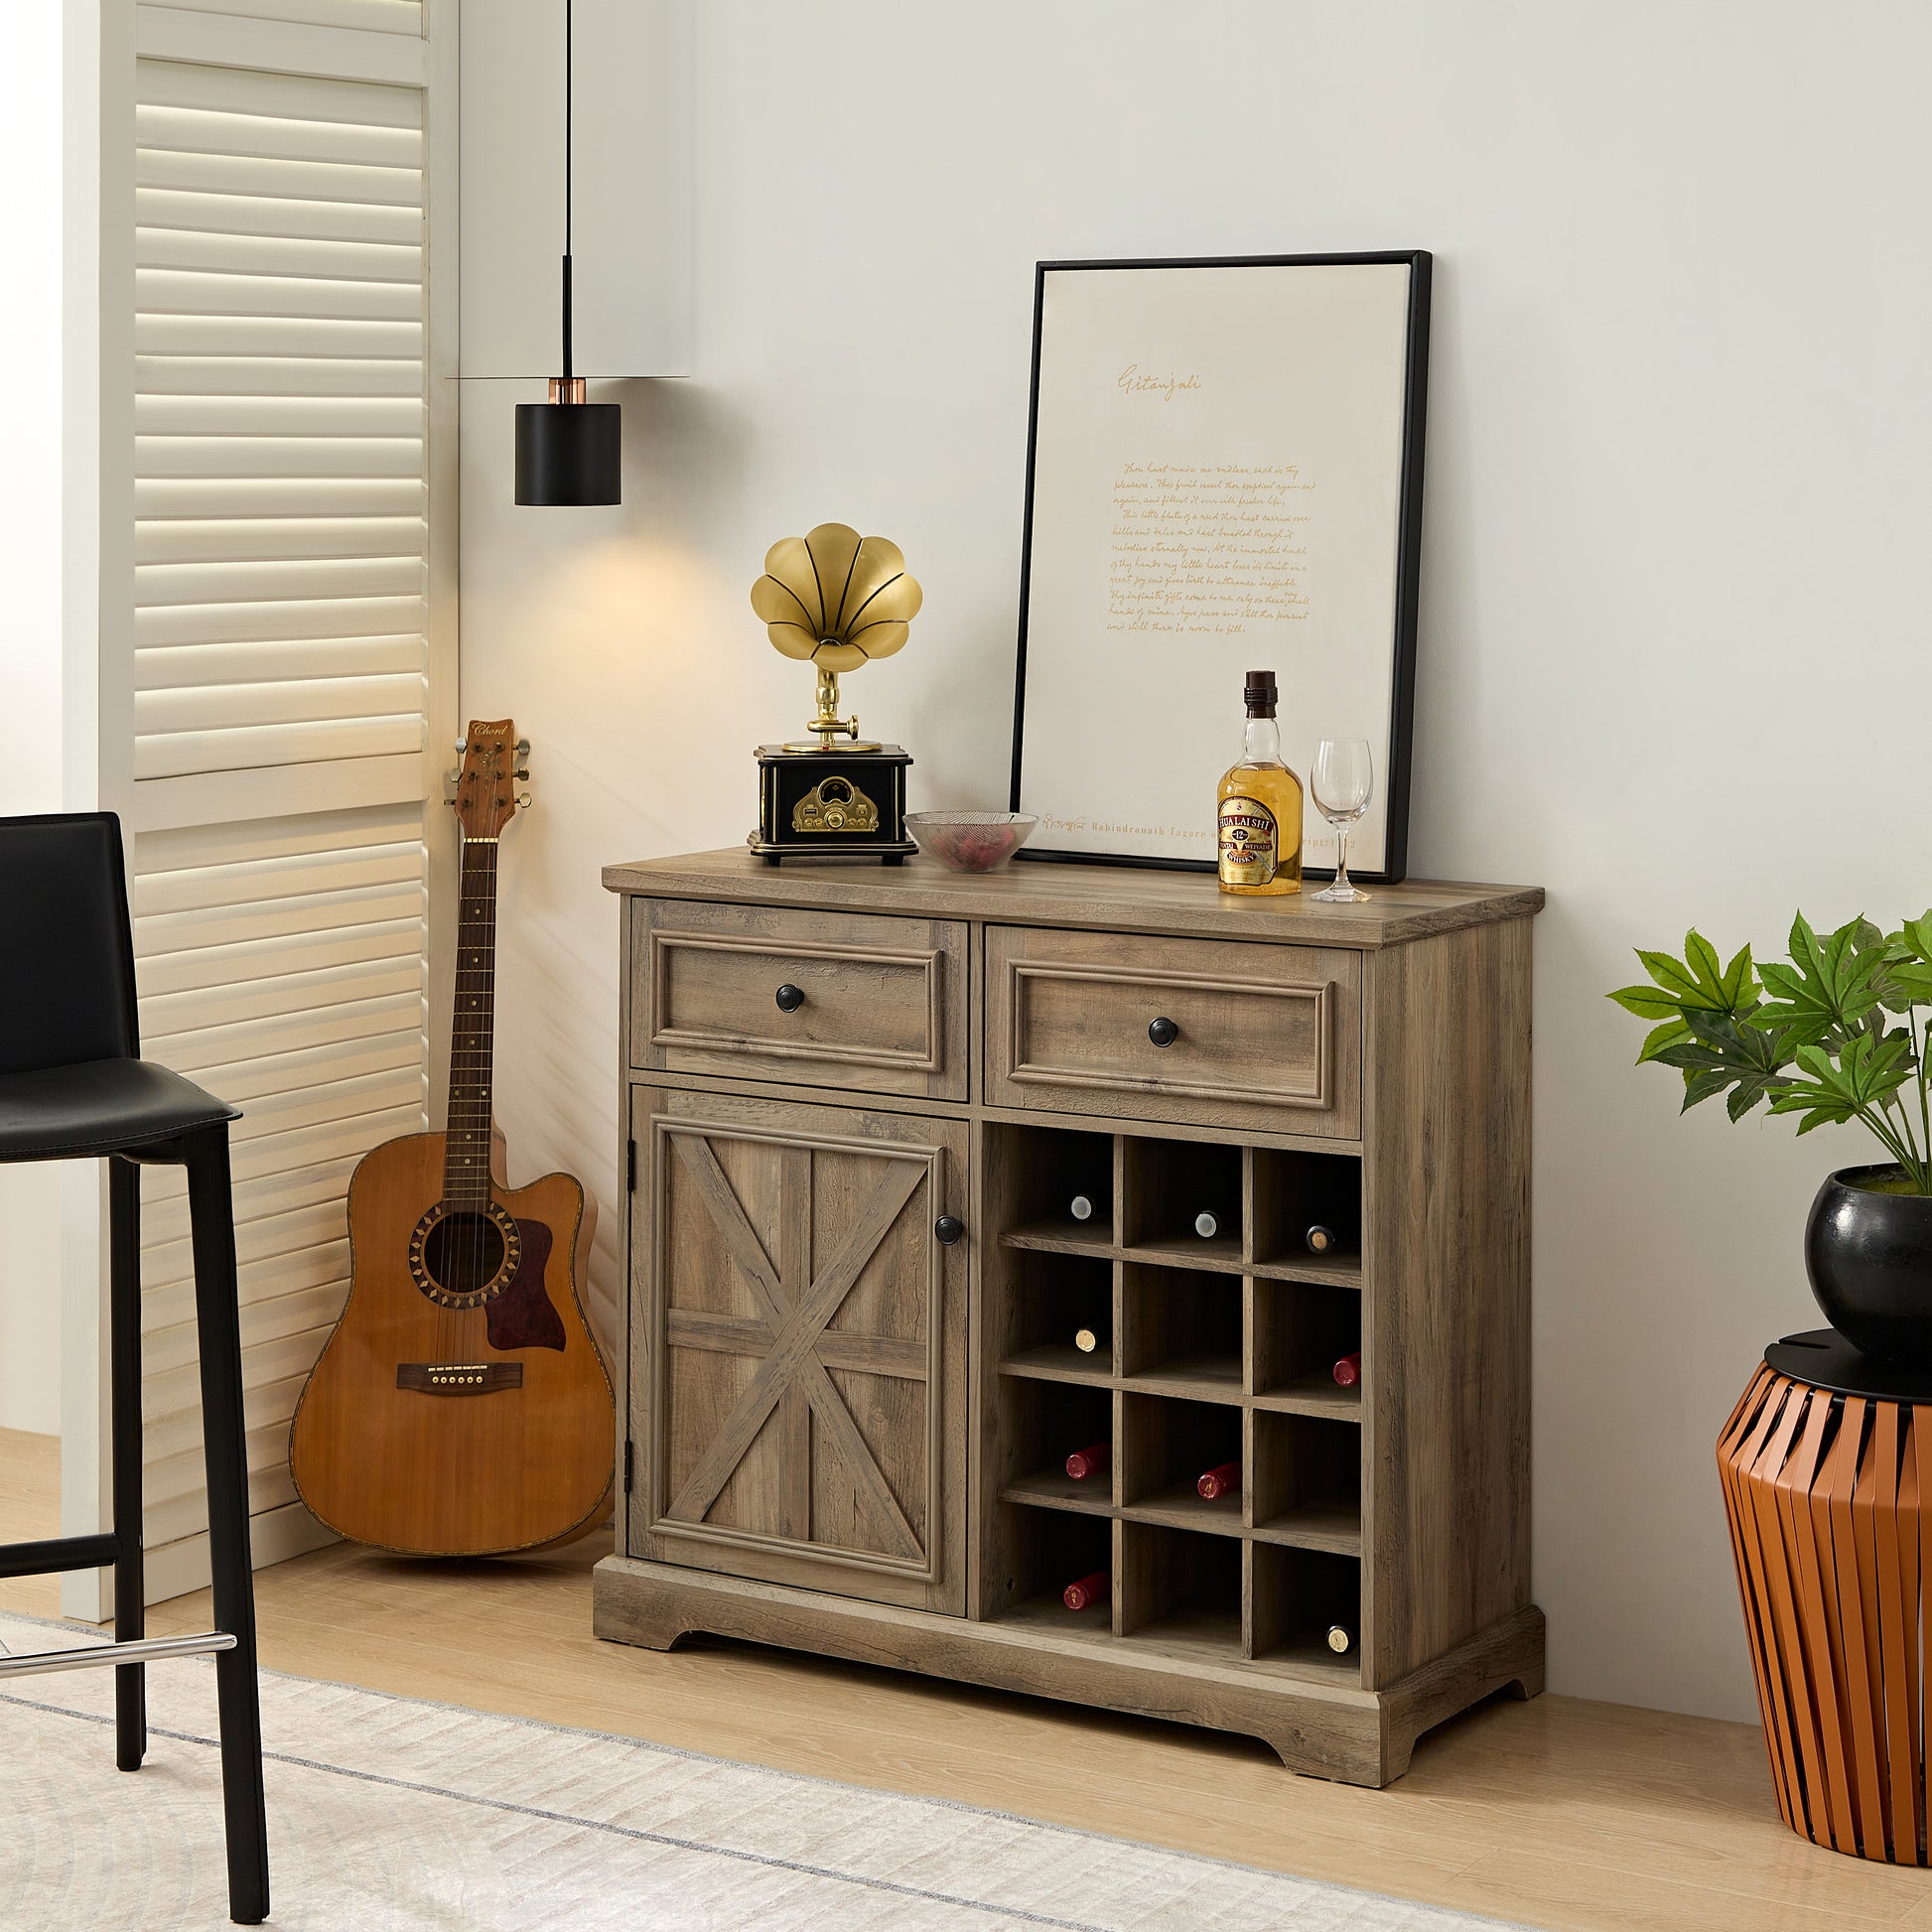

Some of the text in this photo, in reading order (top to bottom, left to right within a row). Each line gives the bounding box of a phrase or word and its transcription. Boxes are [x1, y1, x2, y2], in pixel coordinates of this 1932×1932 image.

[1119, 364, 1201, 401] Gitanjali
[473, 722, 508, 735] Chord
[1092, 821, 1165, 835] Rabindranath
[1170, 826, 1206, 840] Tagore
[1228, 854, 1255, 863] WHISKY
